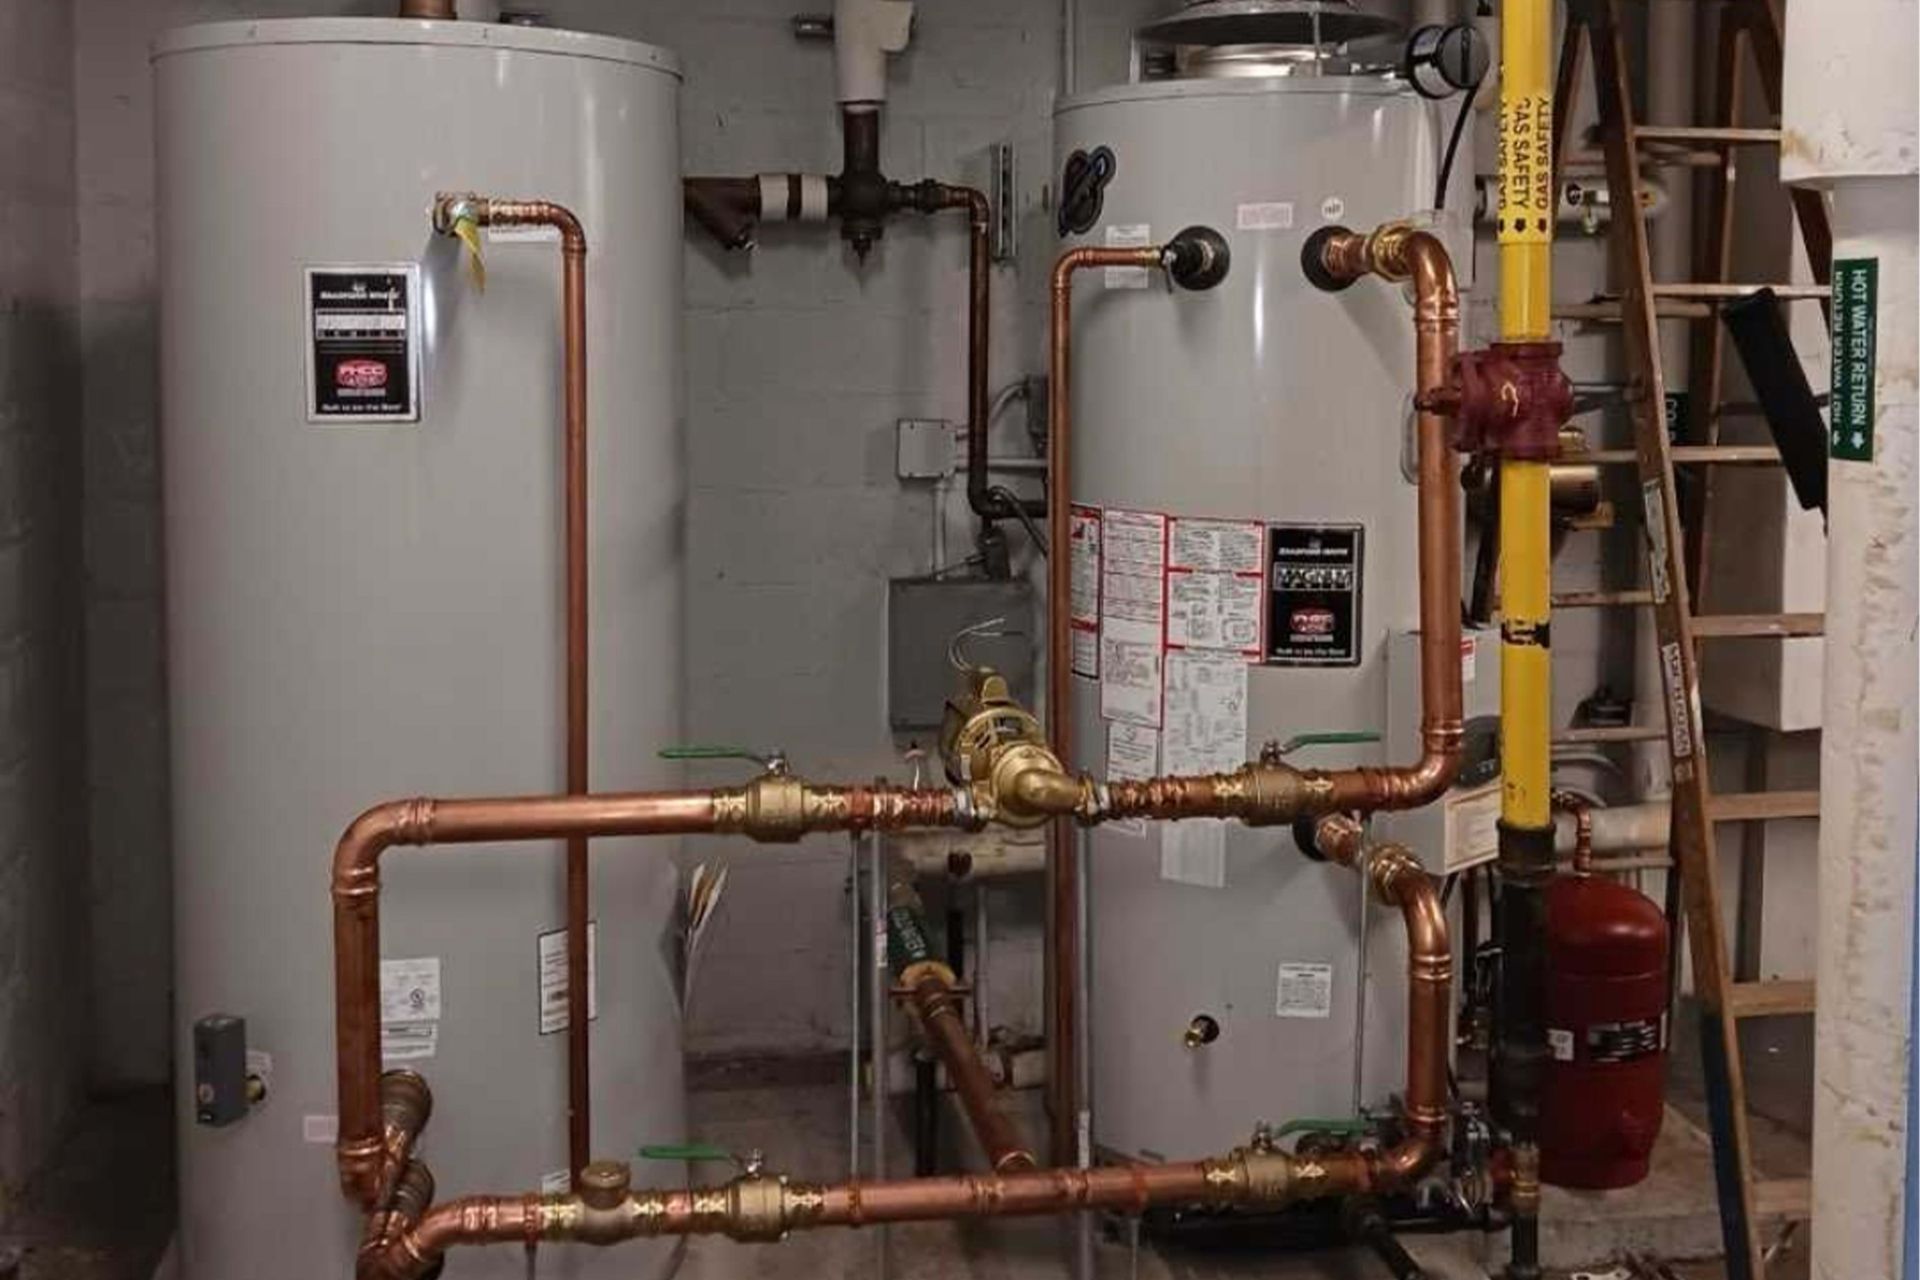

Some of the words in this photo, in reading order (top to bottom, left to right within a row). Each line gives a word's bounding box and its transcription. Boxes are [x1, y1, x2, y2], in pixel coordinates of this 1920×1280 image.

[1535, 97, 1549, 167] SAFETY
[1512, 140, 1531, 209] SAFETY
[1535, 172, 1549, 210] GAS
[1850, 269, 1867, 302] HOT
[1850, 304, 1867, 359] WATER
[1833, 336, 1843, 388] WATER
[1850, 363, 1867, 426] RETURN
